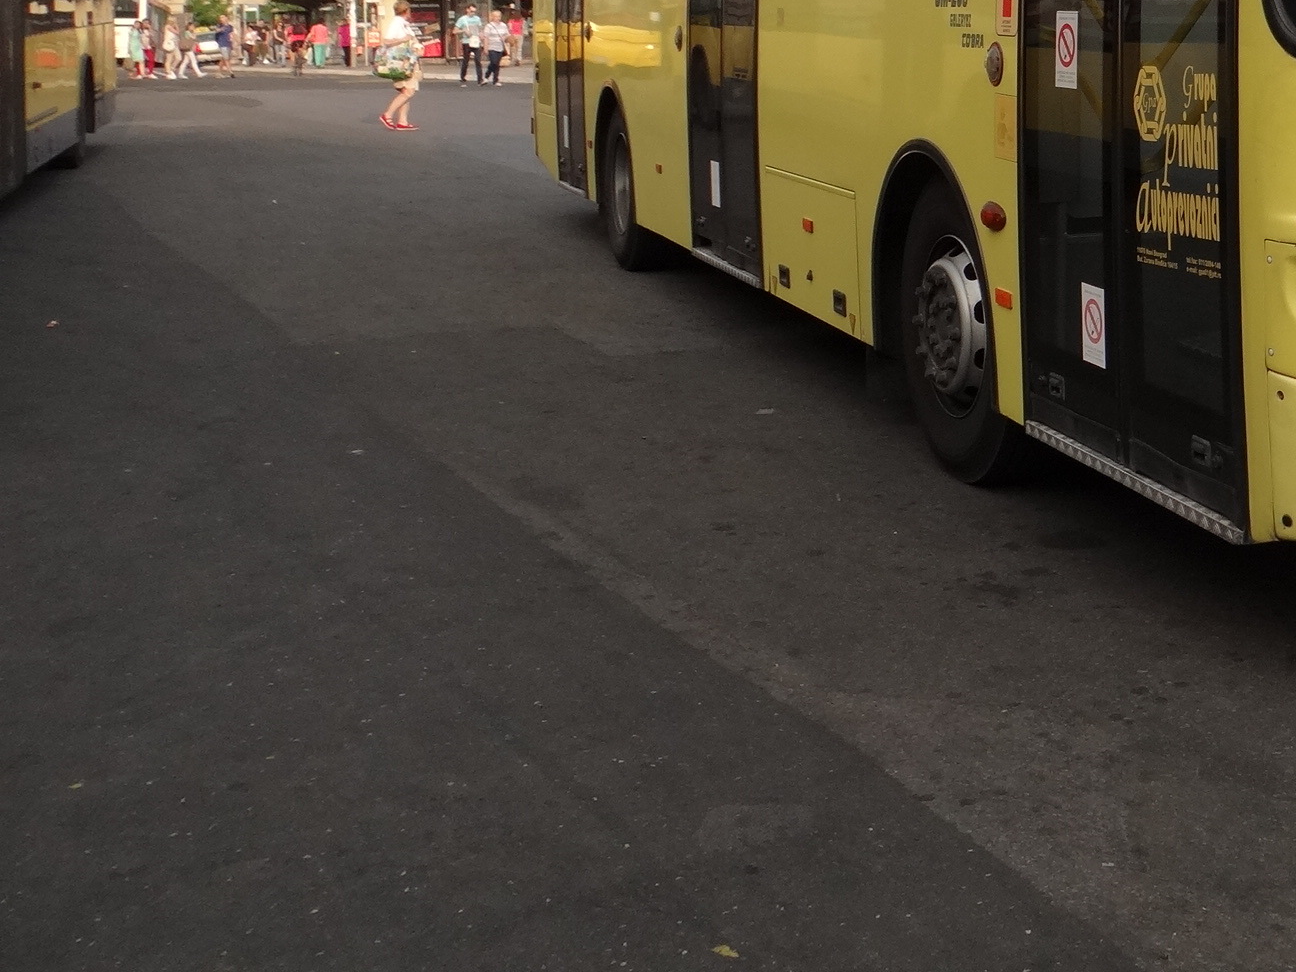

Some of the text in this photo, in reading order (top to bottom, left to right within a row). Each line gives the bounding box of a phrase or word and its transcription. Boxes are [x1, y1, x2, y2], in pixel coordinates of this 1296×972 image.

[962, 32, 985, 49] COBRA
[1183, 59, 1216, 112] Grupa
[1163, 110, 1219, 187] privatni
